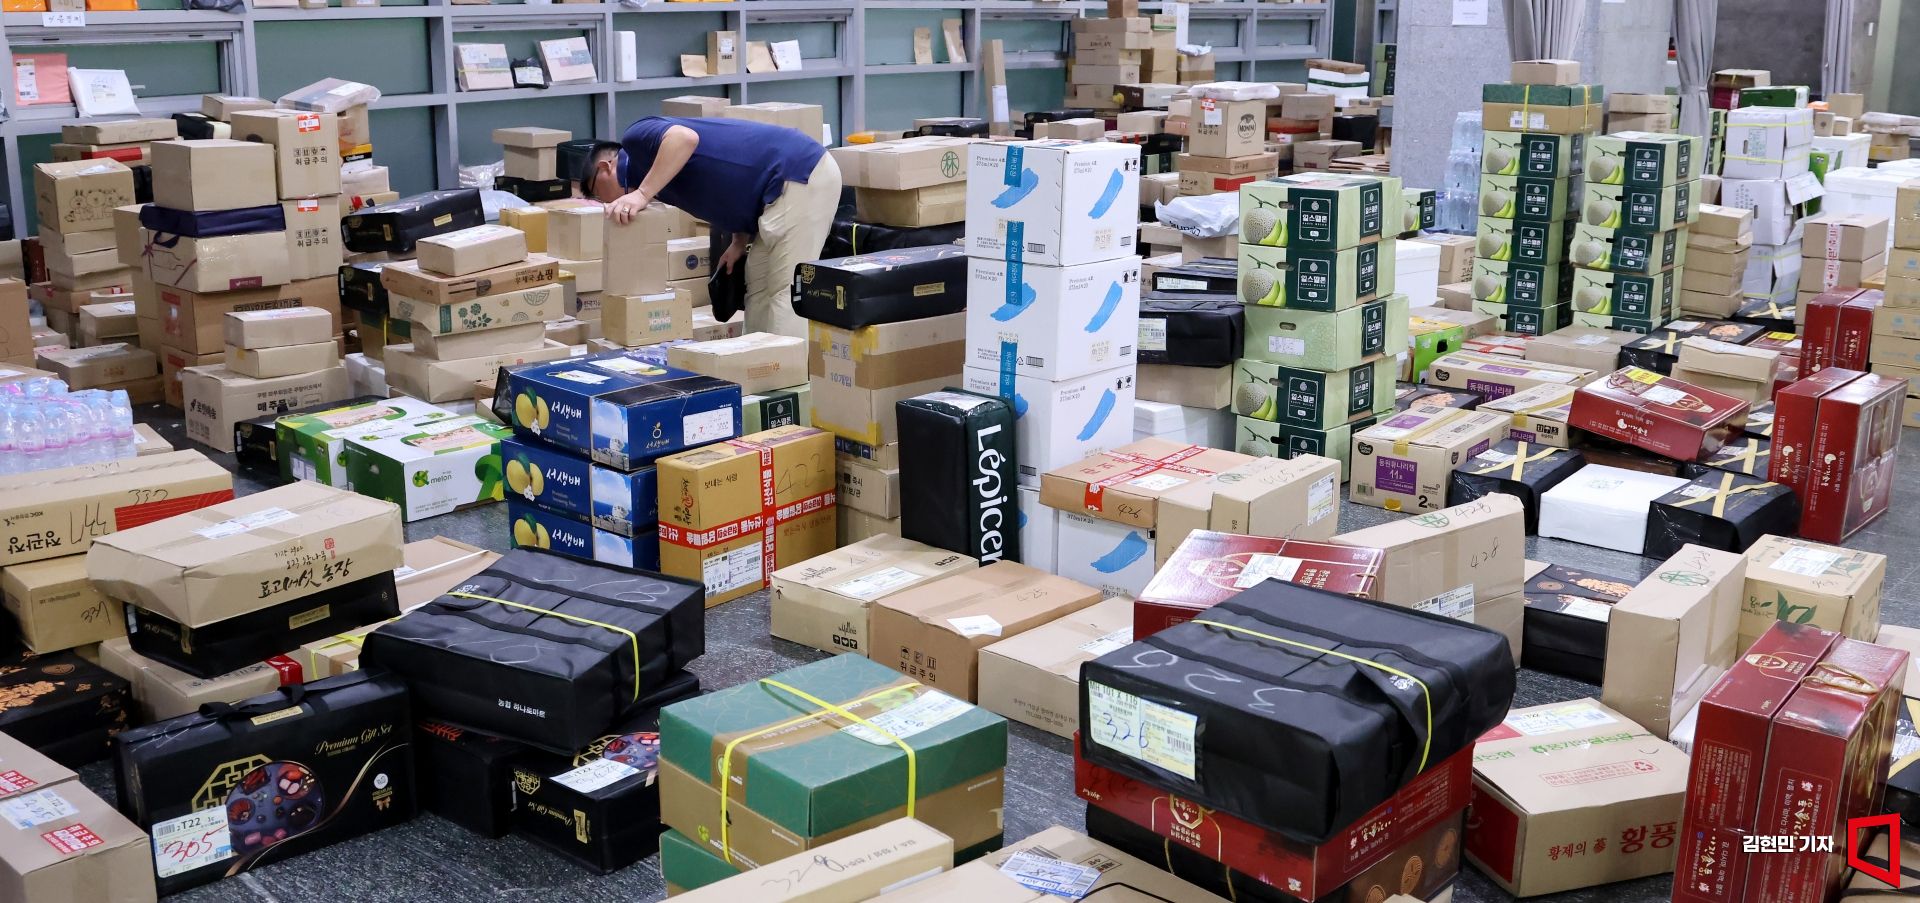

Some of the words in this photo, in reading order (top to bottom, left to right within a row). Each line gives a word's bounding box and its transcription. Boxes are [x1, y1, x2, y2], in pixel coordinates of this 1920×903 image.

[295, 155, 328, 166] 취급주의
[297, 236, 329, 249] 취급주의
[830, 372, 852, 388] 10개입
[551, 400, 582, 419] 서생배
[430, 475, 452, 484] melon
[546, 468, 581, 486] 서생배
[704, 476, 723, 490] 보내는
[725, 472, 738, 483] 사람
[1418, 495, 1428, 508] 2
[741, 515, 763, 534] 선식품
[8, 530, 61, 555] 정관장
[552, 528, 584, 548] 서생배
[258, 567, 322, 599] 표고버섯
[322, 557, 353, 582] 농장
[900, 661, 936, 683] 취급주의
[498, 698, 511, 709] 농협
[513, 703, 546, 718] 하나로마트
[314, 736, 359, 756] Premium
[361, 728, 377, 744] Gift
[377, 724, 393, 737] Set
[1103, 712, 1149, 749] 326
[181, 817, 201, 830] T22
[164, 824, 228, 863] 305
[1548, 841, 1587, 861] 황제의
[1619, 822, 1678, 854] 황풍
